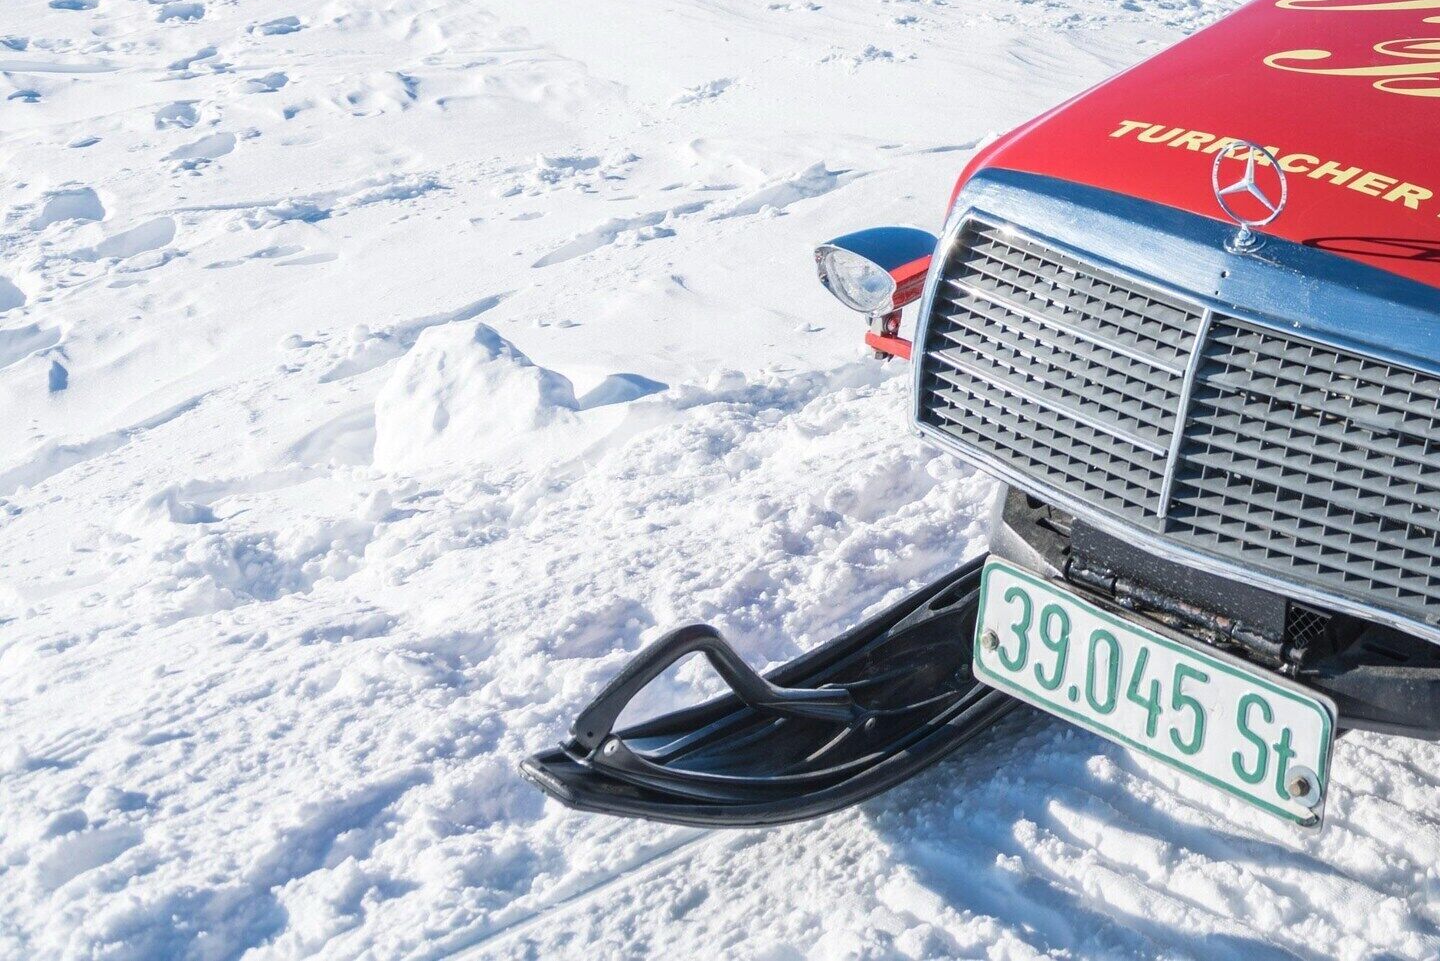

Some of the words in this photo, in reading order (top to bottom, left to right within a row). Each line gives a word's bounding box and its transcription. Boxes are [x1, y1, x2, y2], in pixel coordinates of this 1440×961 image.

[1108, 120, 1433, 210] TURRACHER
[998, 586, 1208, 756] 39.045
[1231, 693, 1296, 801] St
